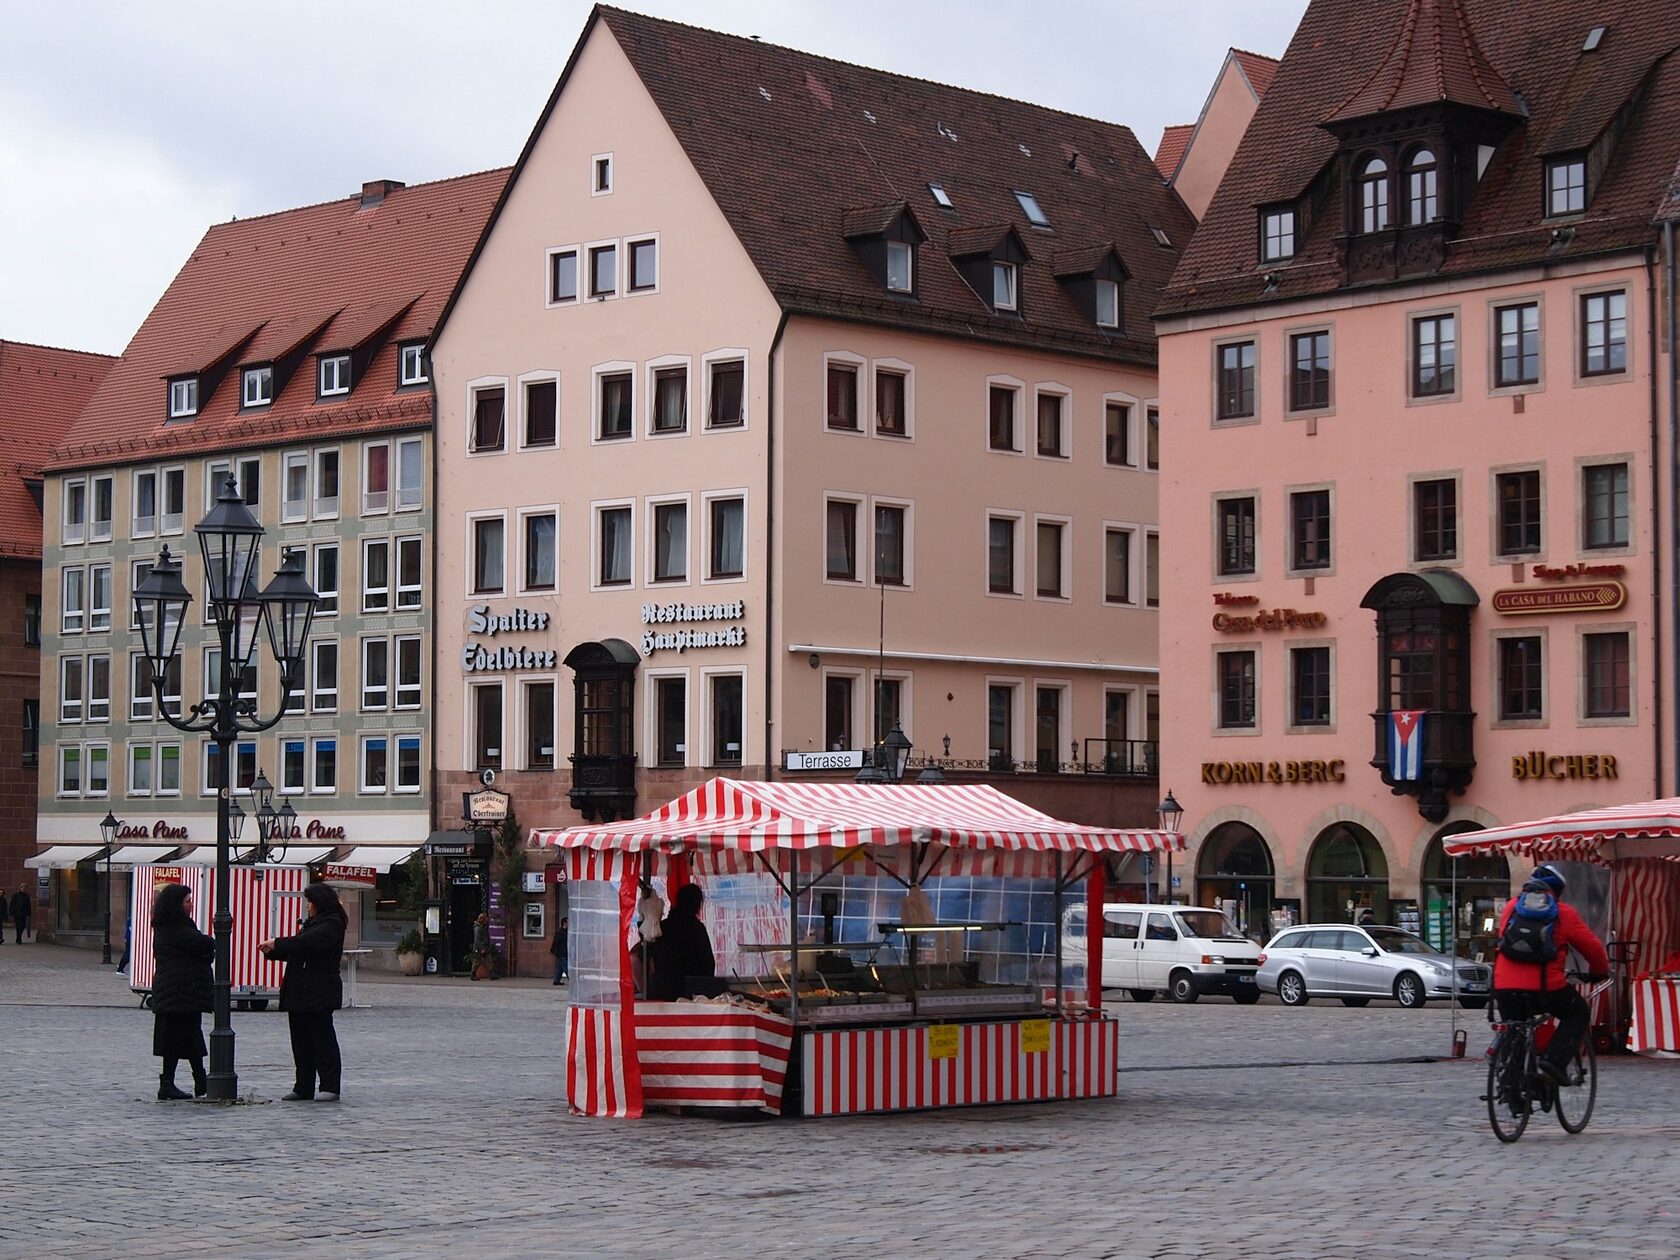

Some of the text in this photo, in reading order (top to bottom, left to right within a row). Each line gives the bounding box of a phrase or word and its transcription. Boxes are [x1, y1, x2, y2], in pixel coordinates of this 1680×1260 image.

[1511, 595, 1535, 606] CASA
[1537, 595, 1552, 604] DEL
[1554, 591, 1595, 604] HABANO
[468, 604, 550, 637] Spalter
[640, 600, 745, 625] Restaurant
[1213, 613, 1254, 633] Casa
[1255, 609, 1283, 630] del
[640, 626, 747, 656] Hauptmarkt
[461, 642, 557, 672] Edelbiere
[798, 754, 852, 768] Terrasse
[1201, 760, 1346, 784] KORN & BERG
[1511, 751, 1619, 780] BÜCHER
[115, 820, 189, 839] Casa Pane
[267, 819, 346, 840] Caa Pane
[155, 867, 180, 878] FALAFEL
[326, 865, 374, 877] FALAFEL
